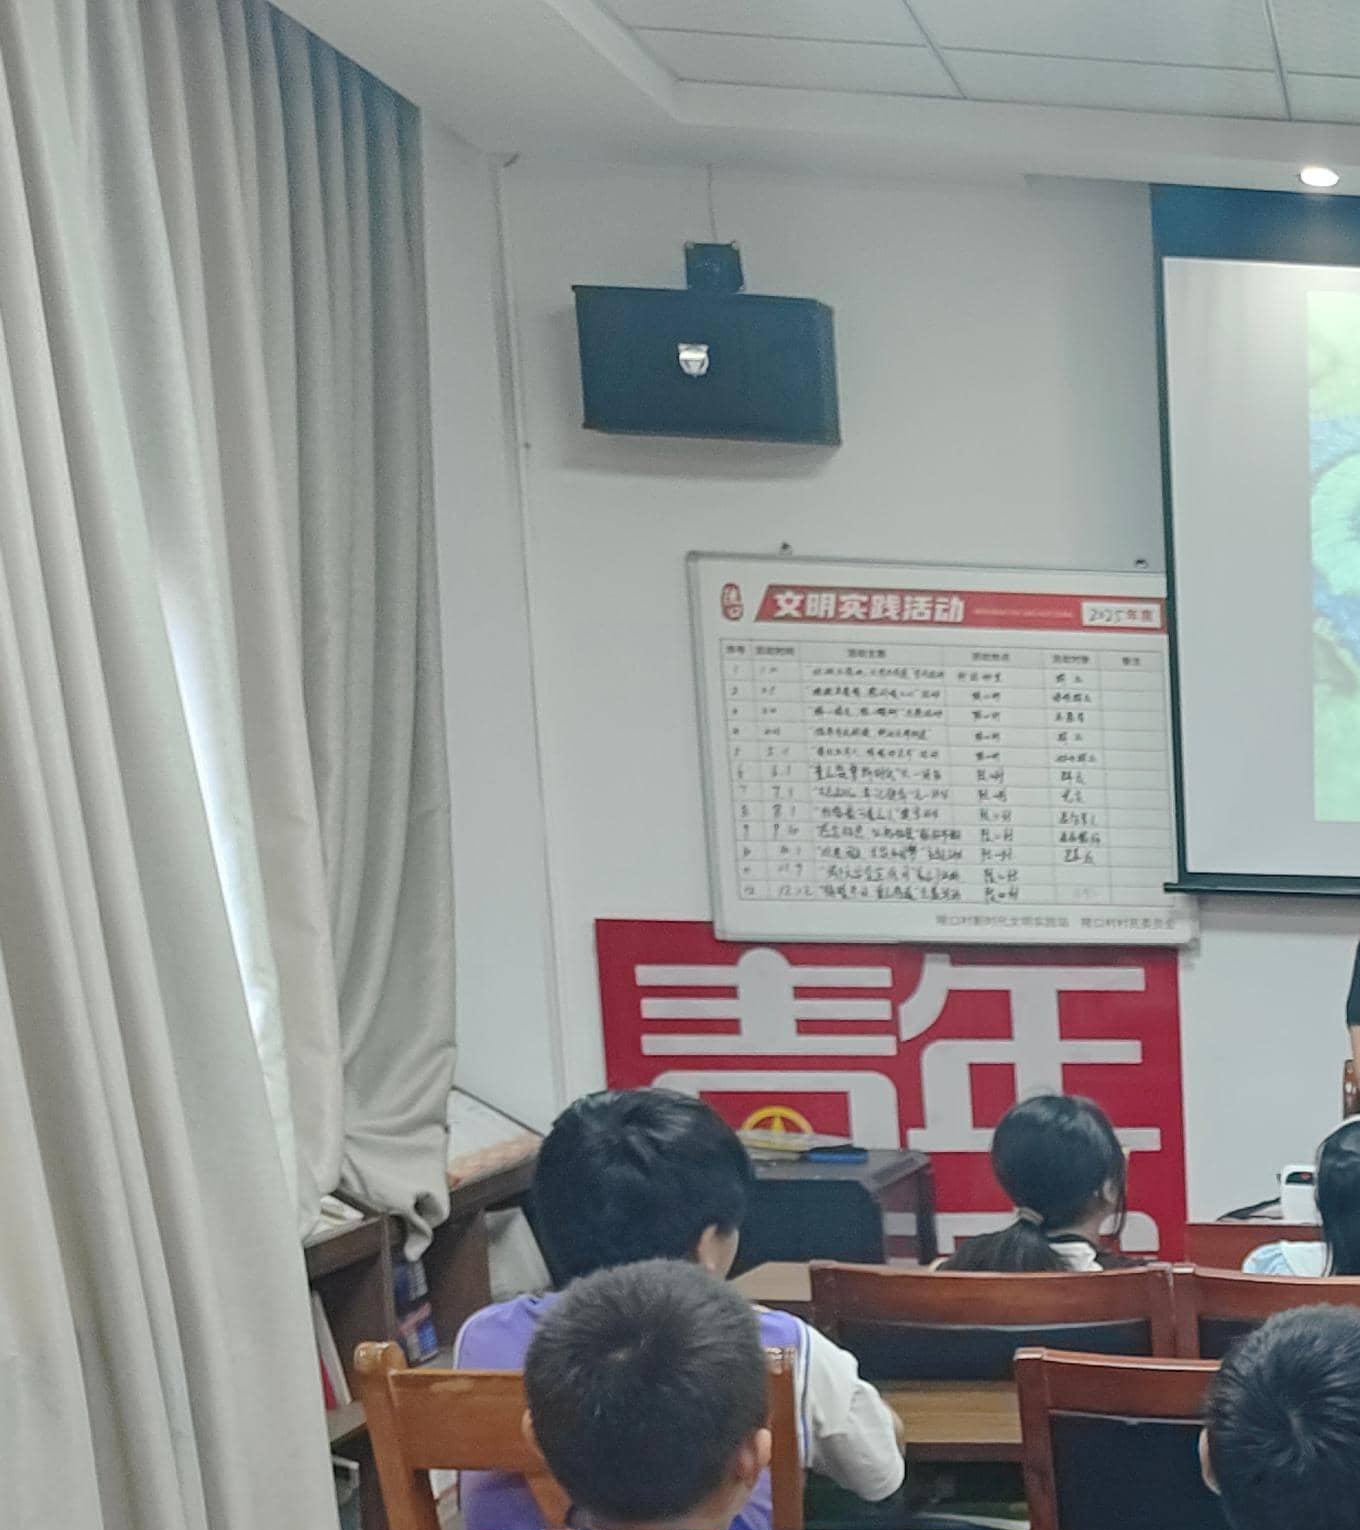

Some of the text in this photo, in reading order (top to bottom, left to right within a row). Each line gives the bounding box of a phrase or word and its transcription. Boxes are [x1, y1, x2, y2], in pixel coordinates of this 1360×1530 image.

[773, 589, 965, 624] 文明实践活动
